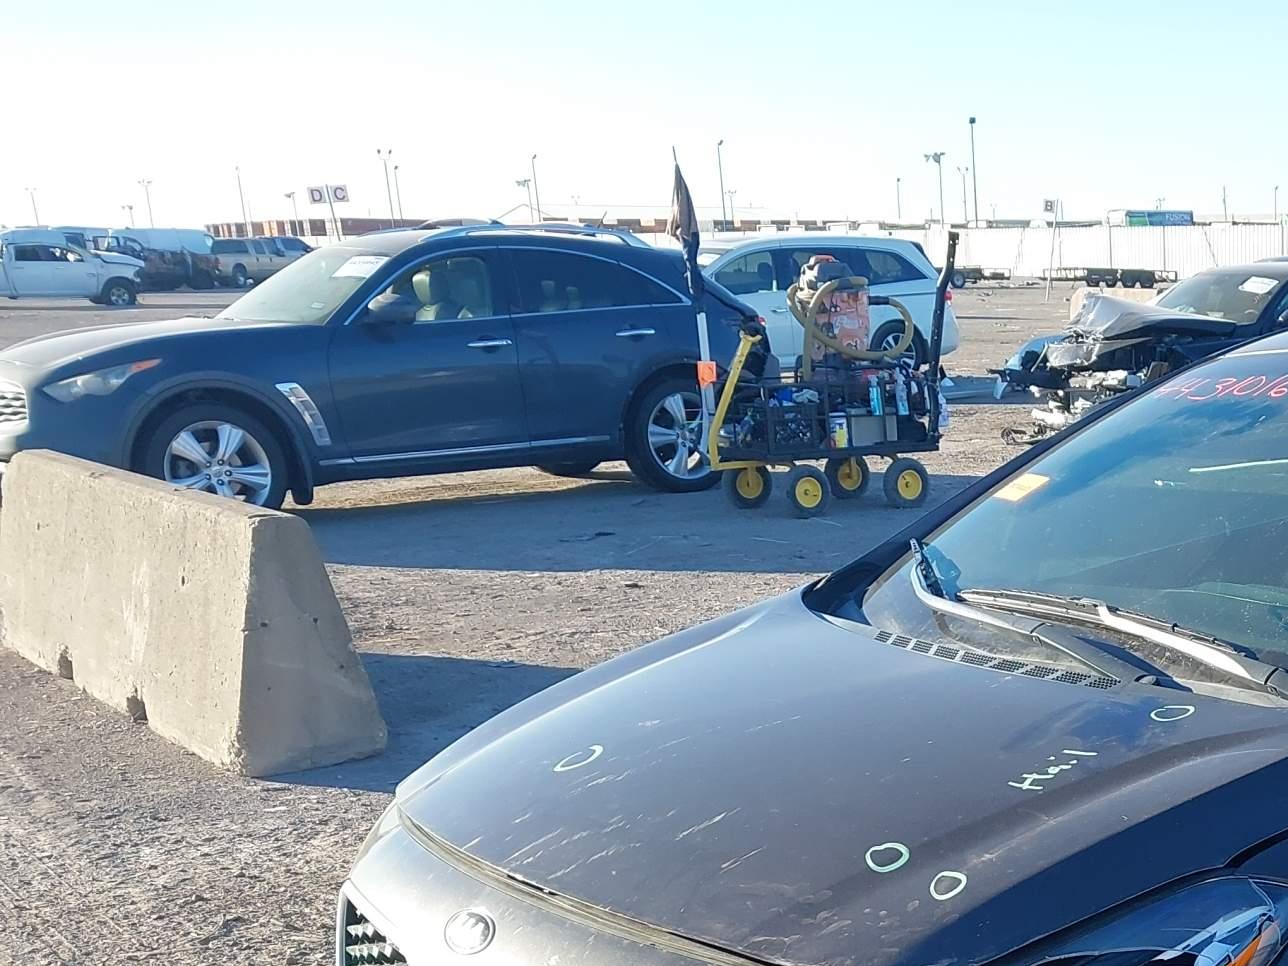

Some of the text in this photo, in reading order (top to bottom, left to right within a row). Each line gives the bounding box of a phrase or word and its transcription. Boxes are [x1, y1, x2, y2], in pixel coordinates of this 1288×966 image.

[310, 189, 323, 202] D
[334, 186, 346, 200] C
[1007, 749, 1099, 791] Hail
